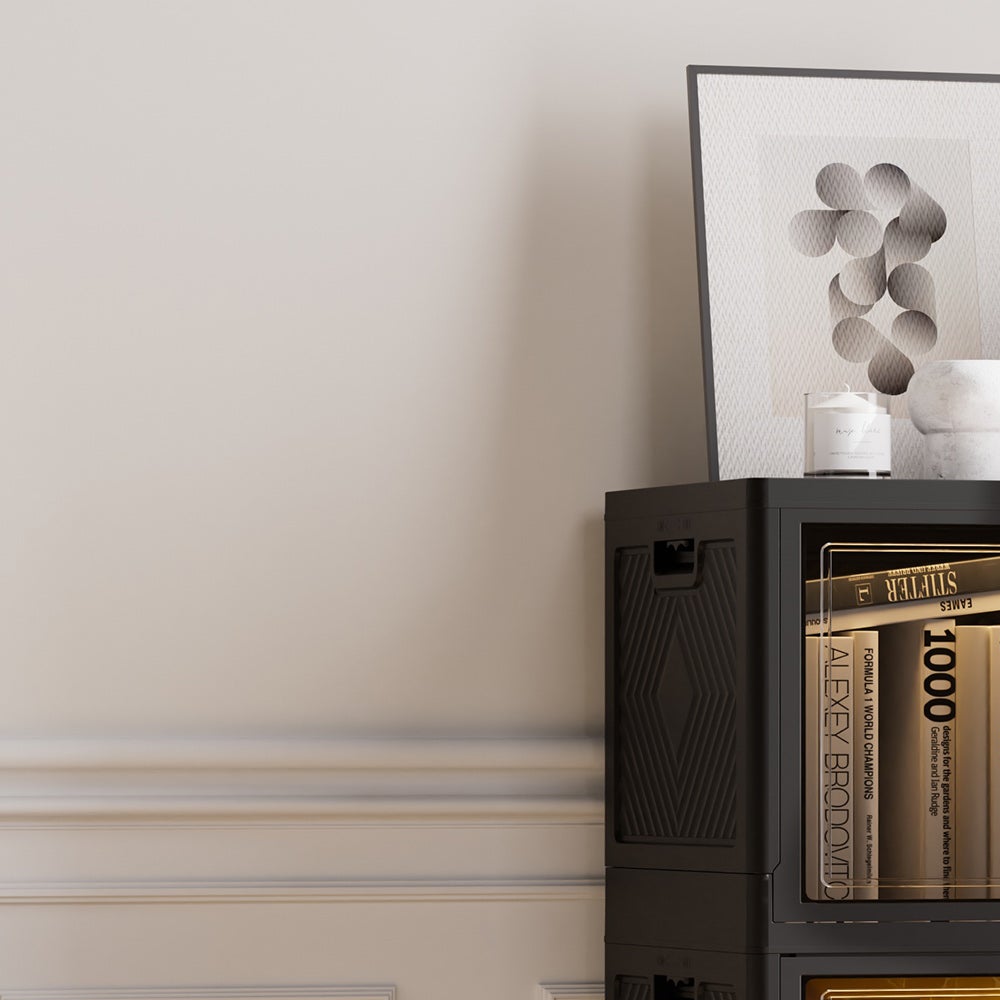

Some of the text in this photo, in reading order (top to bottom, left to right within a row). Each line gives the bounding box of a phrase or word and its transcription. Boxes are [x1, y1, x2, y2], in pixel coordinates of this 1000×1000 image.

[886, 571, 958, 602] STIFTER
[940, 597, 973, 612] EAMES
[864, 648, 874, 695] FORMULA
[923, 628, 957, 723] 1000
[864, 705, 874, 740] WORLD
[941, 725, 952, 755] designs
[864, 744, 874, 800] CHAMPIONS
[928, 726, 941, 816] Geraldine and Ian Rudge
[943, 757, 952, 768] for
[943, 769, 952, 782] the
[941, 783, 952, 813] gardens
[943, 815, 952, 829] and
[943, 831, 952, 855] where
[943, 856, 952, 865] to
